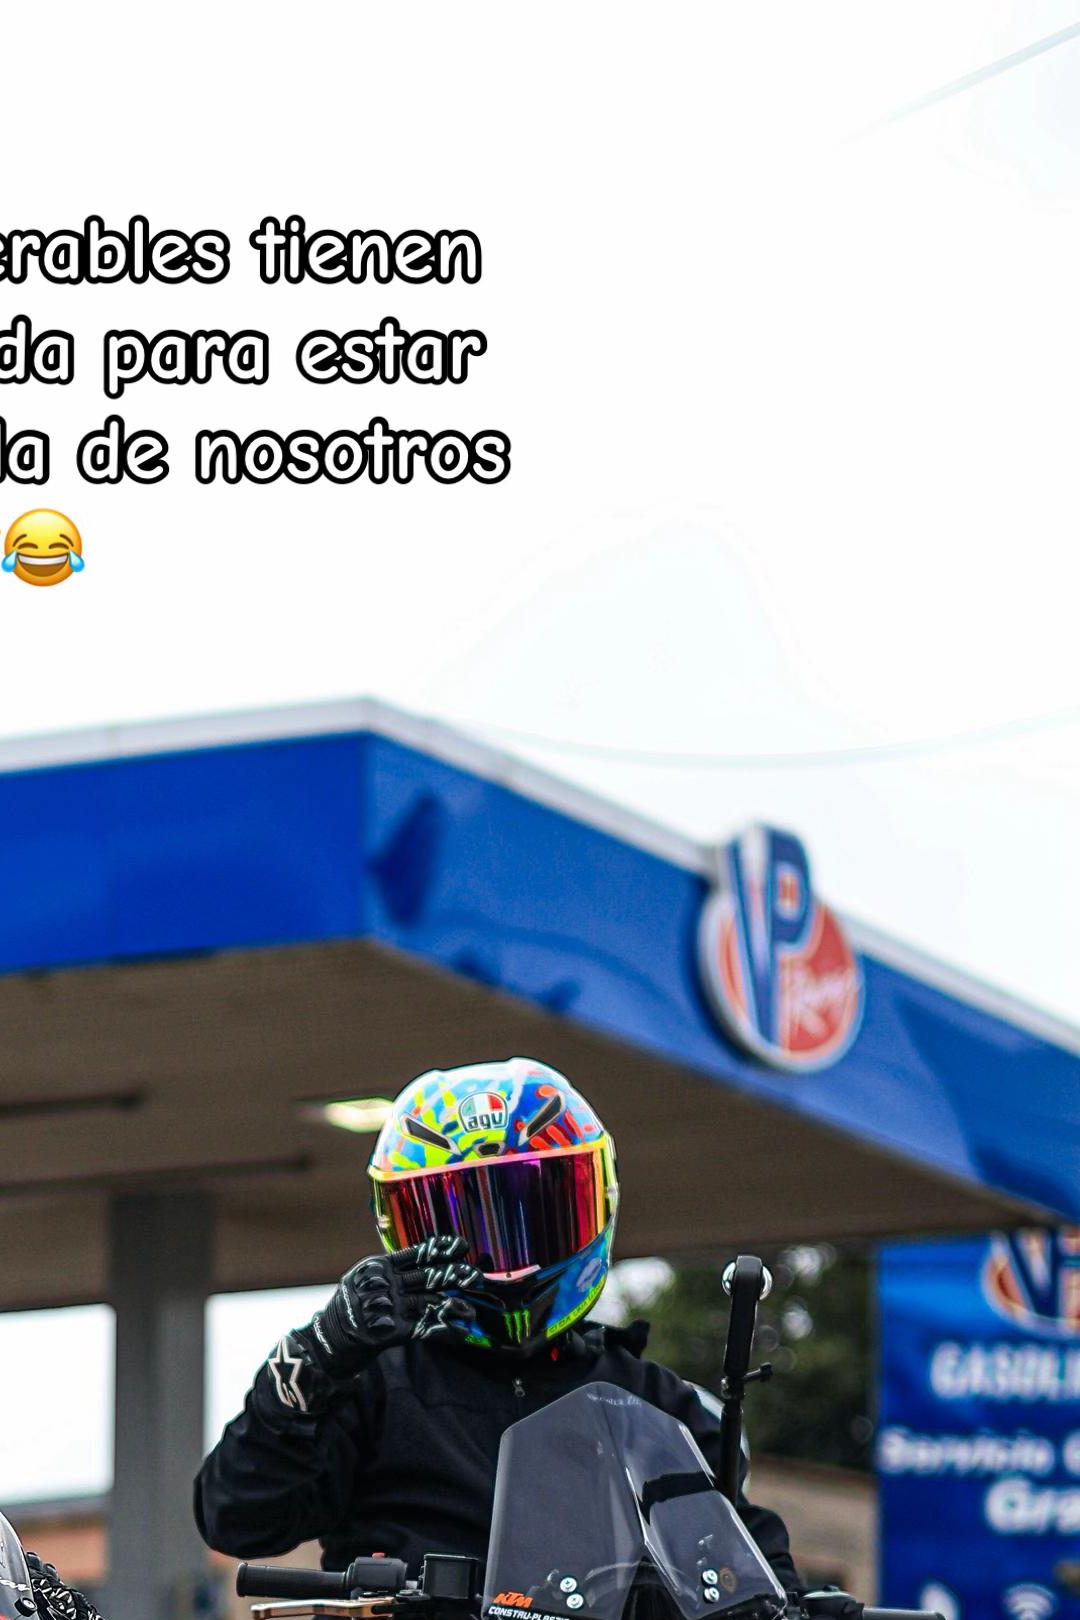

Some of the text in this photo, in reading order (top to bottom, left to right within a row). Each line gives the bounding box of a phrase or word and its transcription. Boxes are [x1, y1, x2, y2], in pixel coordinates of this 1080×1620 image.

[724, 824, 812, 1048] VP
[467, 1110, 504, 1129] agv
[492, 1591, 534, 1609] KTM
